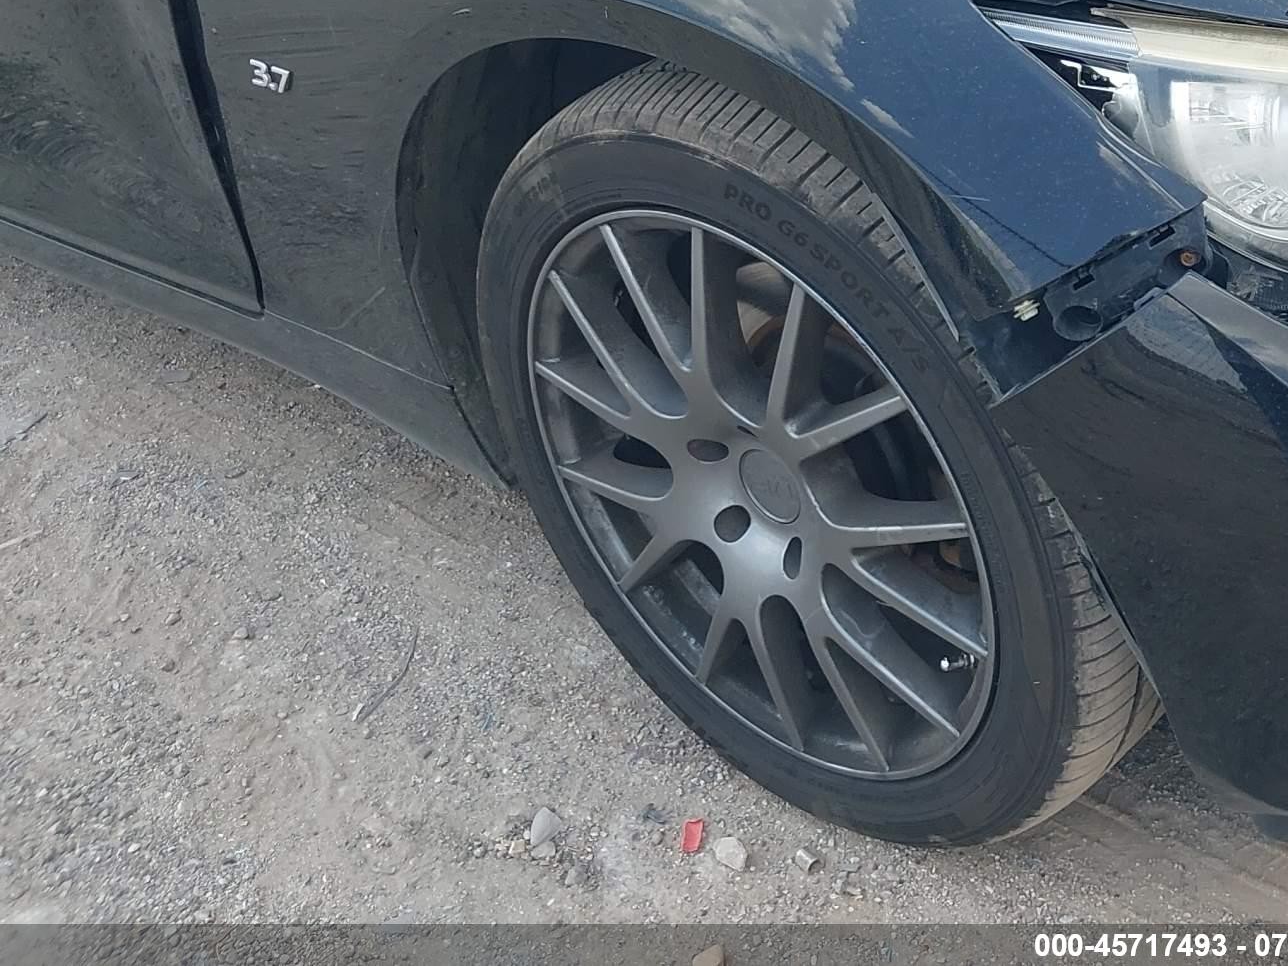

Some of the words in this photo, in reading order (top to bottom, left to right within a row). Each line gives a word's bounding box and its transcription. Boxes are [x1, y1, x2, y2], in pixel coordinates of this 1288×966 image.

[249, 58, 290, 94] 3.7
[724, 183, 772, 221] PRO
[778, 219, 809, 247] G6
[810, 243, 890, 319] SPORT
